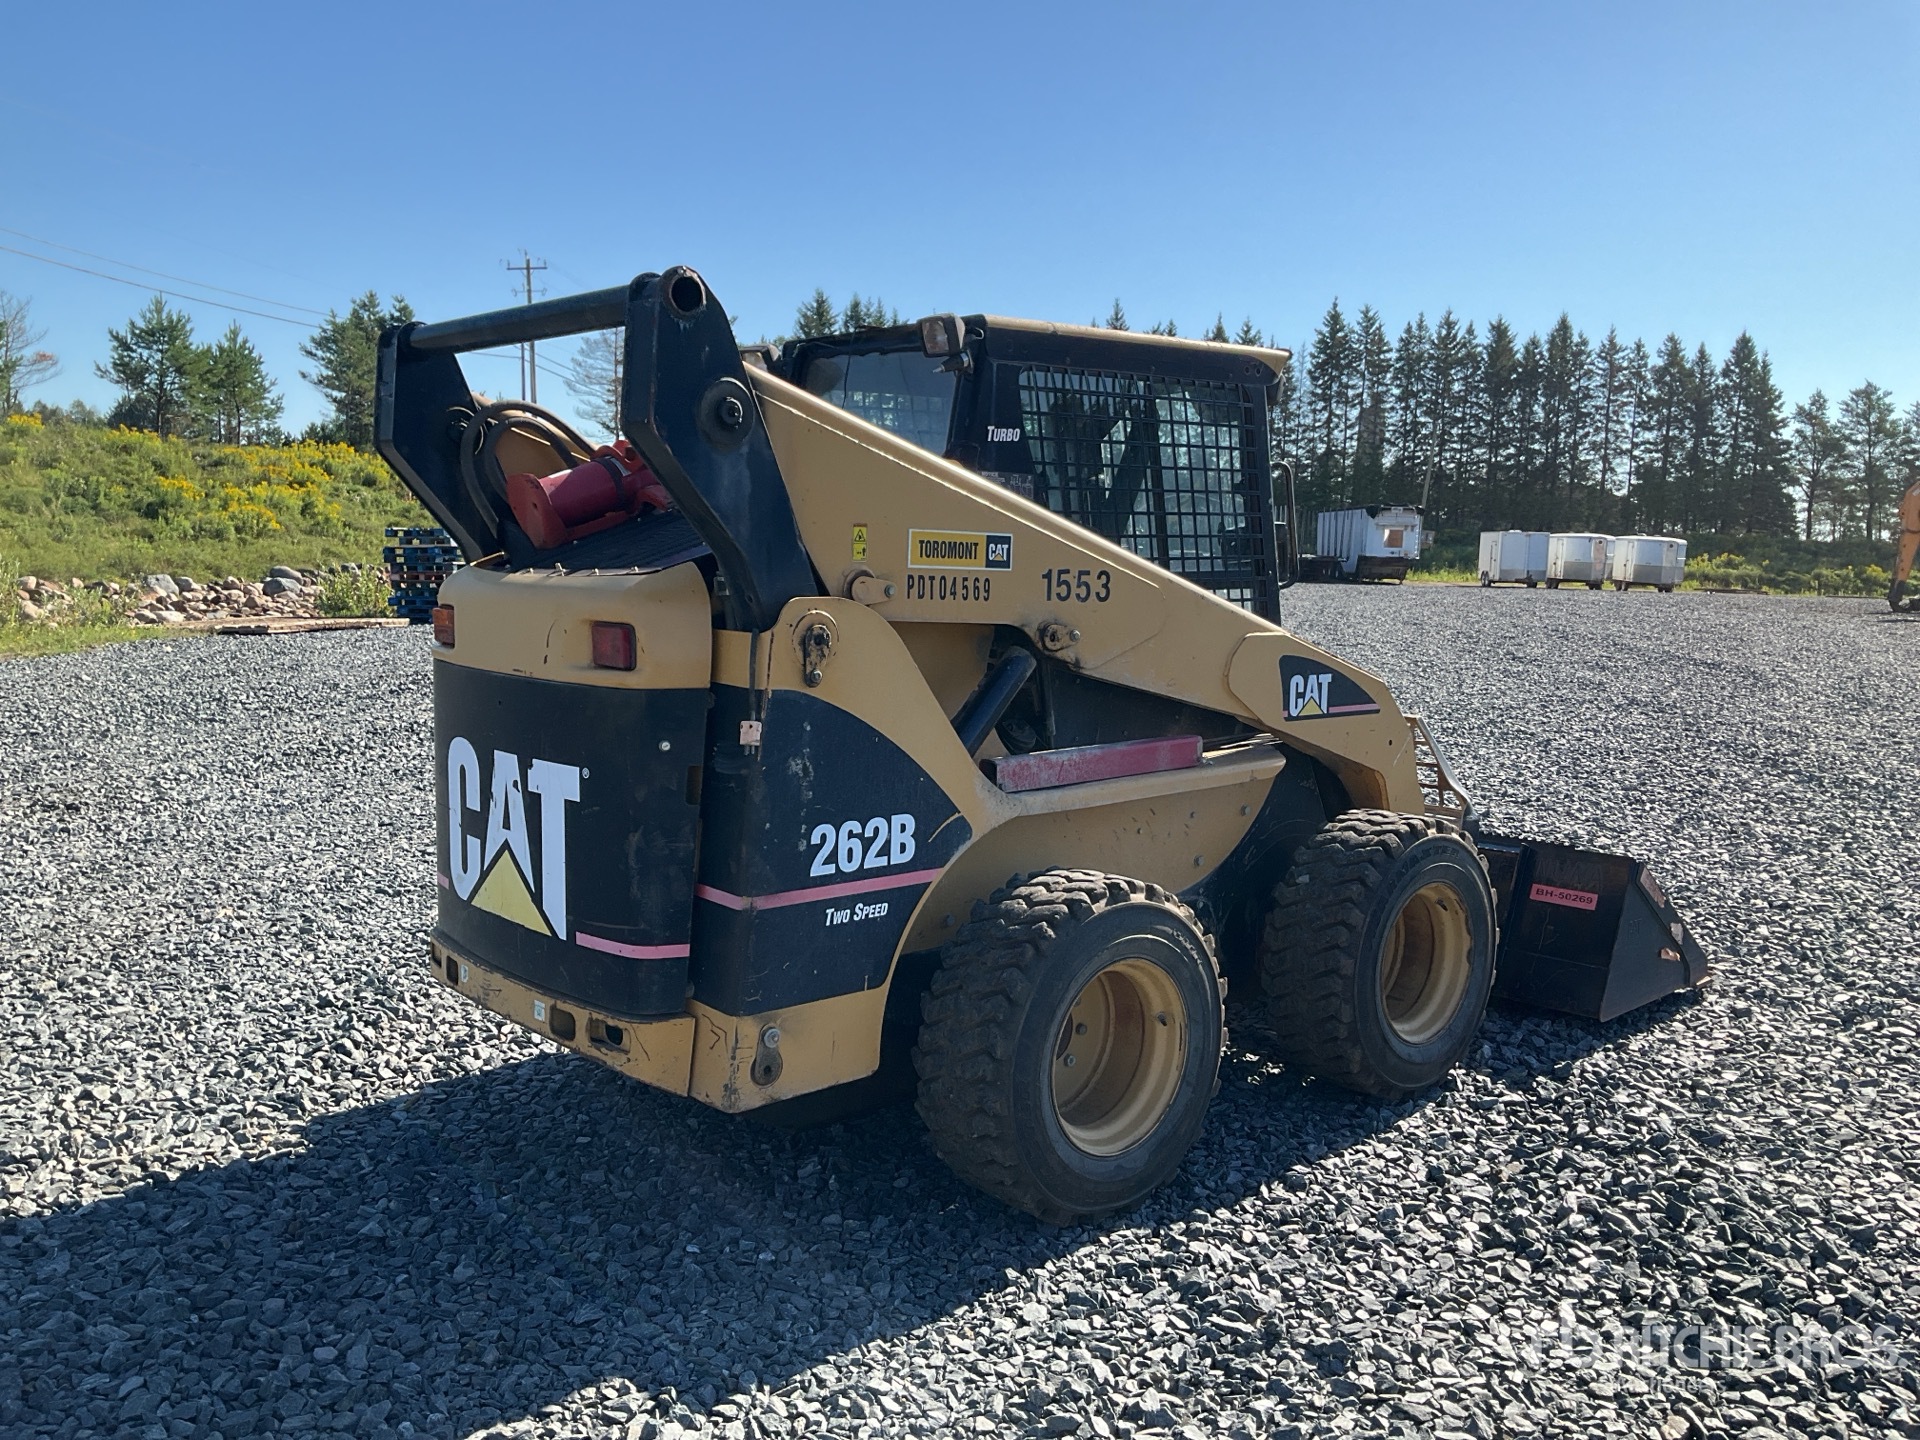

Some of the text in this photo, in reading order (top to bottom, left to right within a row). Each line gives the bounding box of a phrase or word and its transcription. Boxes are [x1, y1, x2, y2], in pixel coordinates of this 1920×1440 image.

[919, 539, 979, 560] TOROMONT
[988, 543, 1009, 561] CAT
[1041, 568, 1111, 603] 1553
[1289, 673, 1332, 717] CAT
[448, 736, 581, 941] CAT
[810, 813, 916, 877] 262B
[1535, 888, 1593, 905] BH-50269
